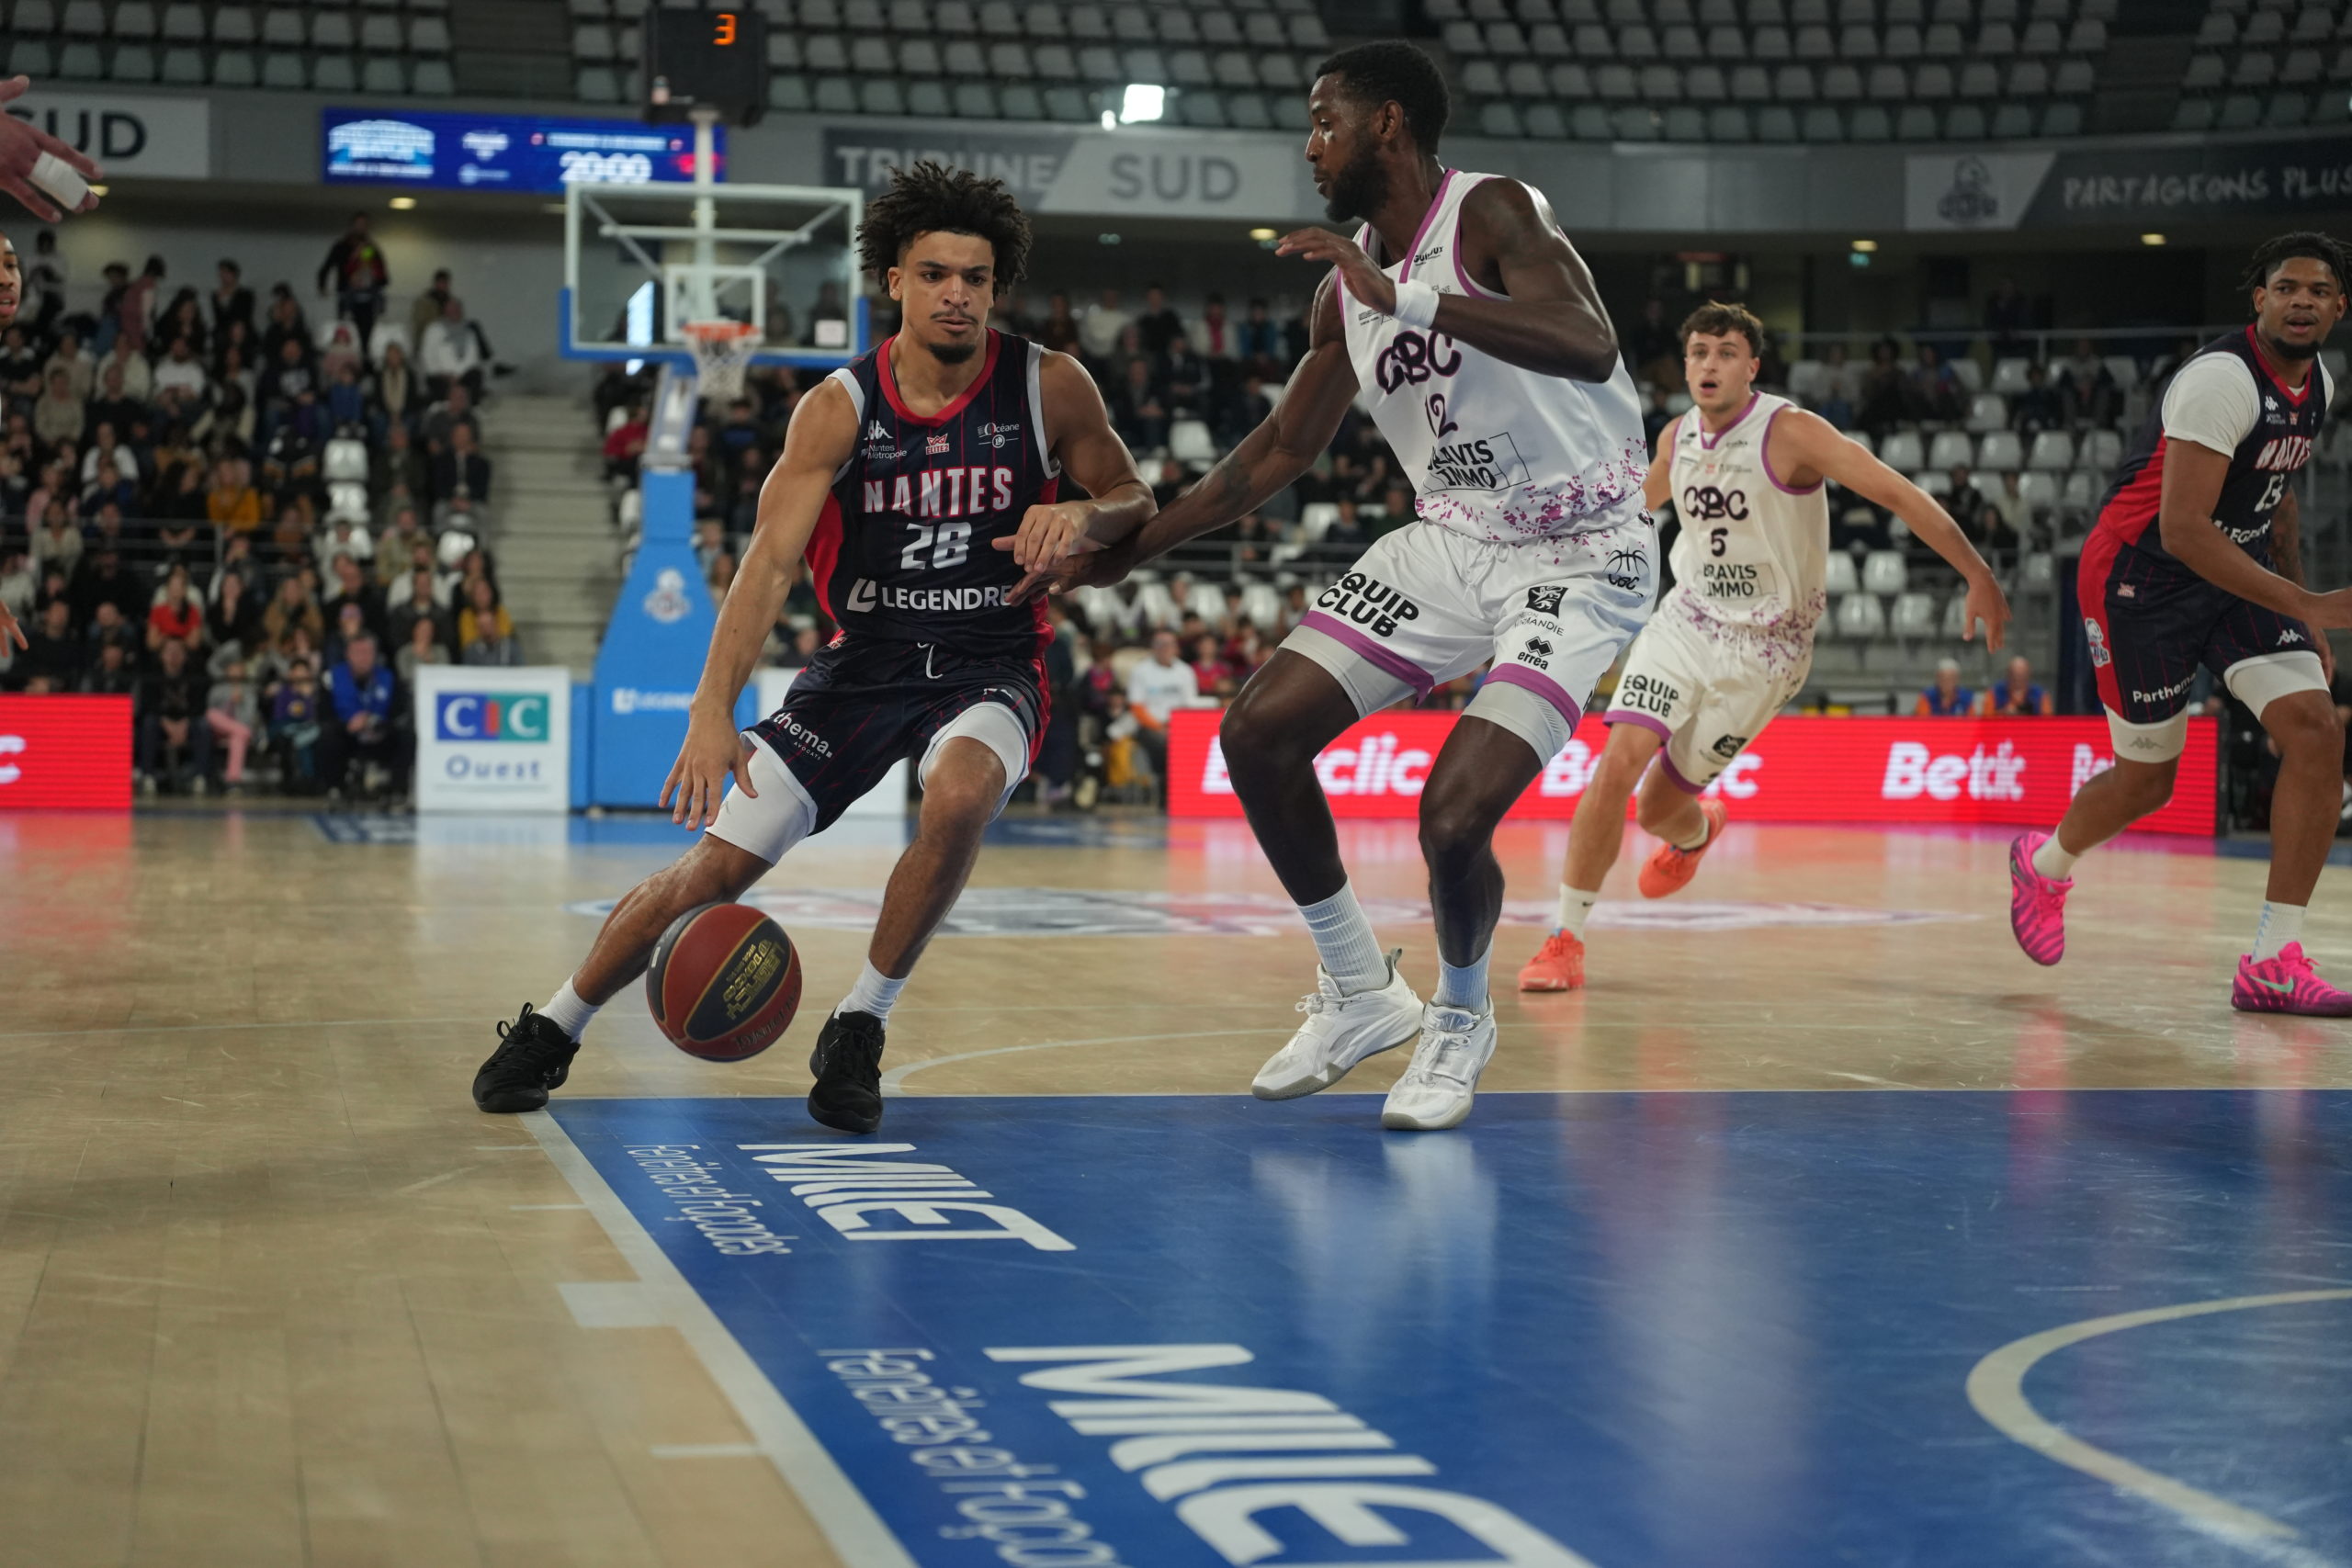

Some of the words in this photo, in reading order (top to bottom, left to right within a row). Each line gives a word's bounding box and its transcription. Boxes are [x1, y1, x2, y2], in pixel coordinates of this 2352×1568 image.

[713, 14, 736, 45] 3
[1110, 152, 1241, 202] SUD
[2063, 167, 2270, 209] PARTAGEONS
[864, 467, 1012, 516] NANTES
[1684, 486, 1749, 521] CBC
[900, 521, 972, 570] 28
[1711, 527, 1728, 557] 5
[882, 585, 1012, 611] LEGENDRE
[1706, 581, 1754, 597] IMMO
[1317, 588, 1398, 637] CLUB
[1622, 691, 1672, 718] CLUB
[1623, 675, 1679, 702] EQUIP
[443, 697, 541, 737] CIC
[446, 755, 540, 778] Ouest
[622, 1145, 723, 1186] Fenêtres
[662, 1185, 752, 1197] et
[736, 1142, 1078, 1251] MILLET
[663, 1193, 800, 1257] Façades
[816, 1347, 992, 1444] Fenêtres
[939, 1480, 1139, 1568] Faça
